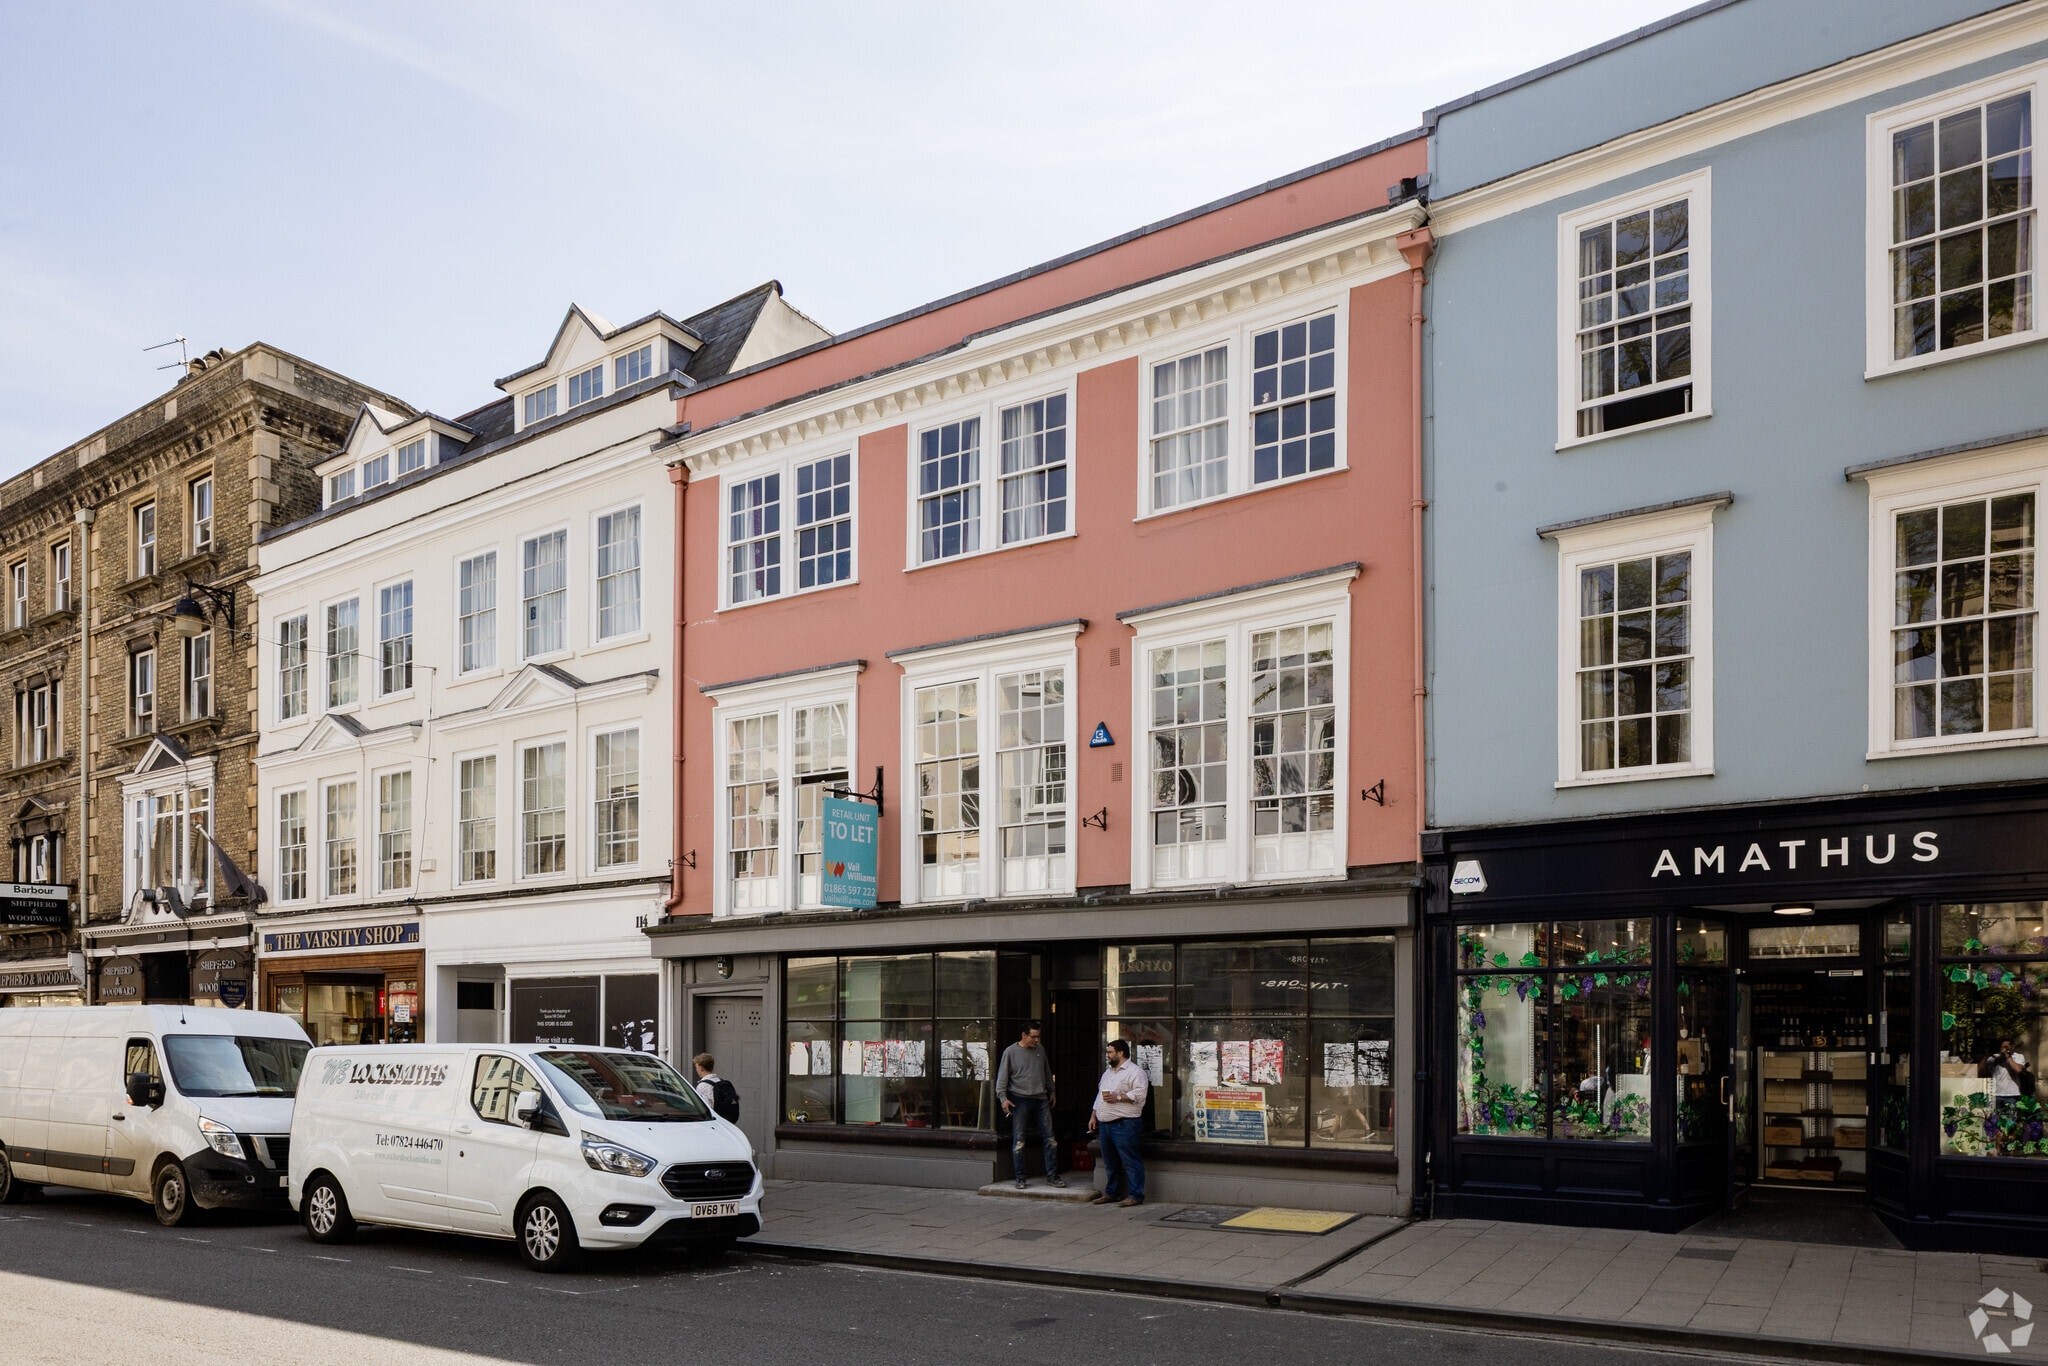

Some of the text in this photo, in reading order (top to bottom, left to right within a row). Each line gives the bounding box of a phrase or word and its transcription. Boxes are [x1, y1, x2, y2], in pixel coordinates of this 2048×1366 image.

[832, 808, 870, 822] RETAIL UNIT
[828, 821, 874, 844] TO LET
[1651, 831, 1939, 878] AMATHUS
[847, 862, 860, 872] Vail
[847, 872, 876, 882] Williams
[1454, 877, 1480, 885] SECOM
[13, 885, 54, 895] Barbour
[824, 883, 876, 897] 01865 597 222
[11, 900, 57, 908] SHEPHERD
[824, 895, 876, 907] vailwilliams.com
[8, 914, 61, 922] WOODWARD
[636, 914, 648, 928] 114
[276, 934, 300, 950] THE
[305, 928, 362, 948] VARSITY
[365, 925, 404, 944] SHOP
[408, 932, 419, 942] 113
[104, 966, 134, 976] SHEPHERD
[115, 976, 121, 986] &
[102, 986, 136, 996] WOODWARD
[198, 982, 218, 992] WOOD
[349, 1064, 448, 1086] LOCKSMITHS
[376, 1134, 443, 1151] Tel: 07824 446470
[696, 1203, 736, 1216] OV68 TYK
